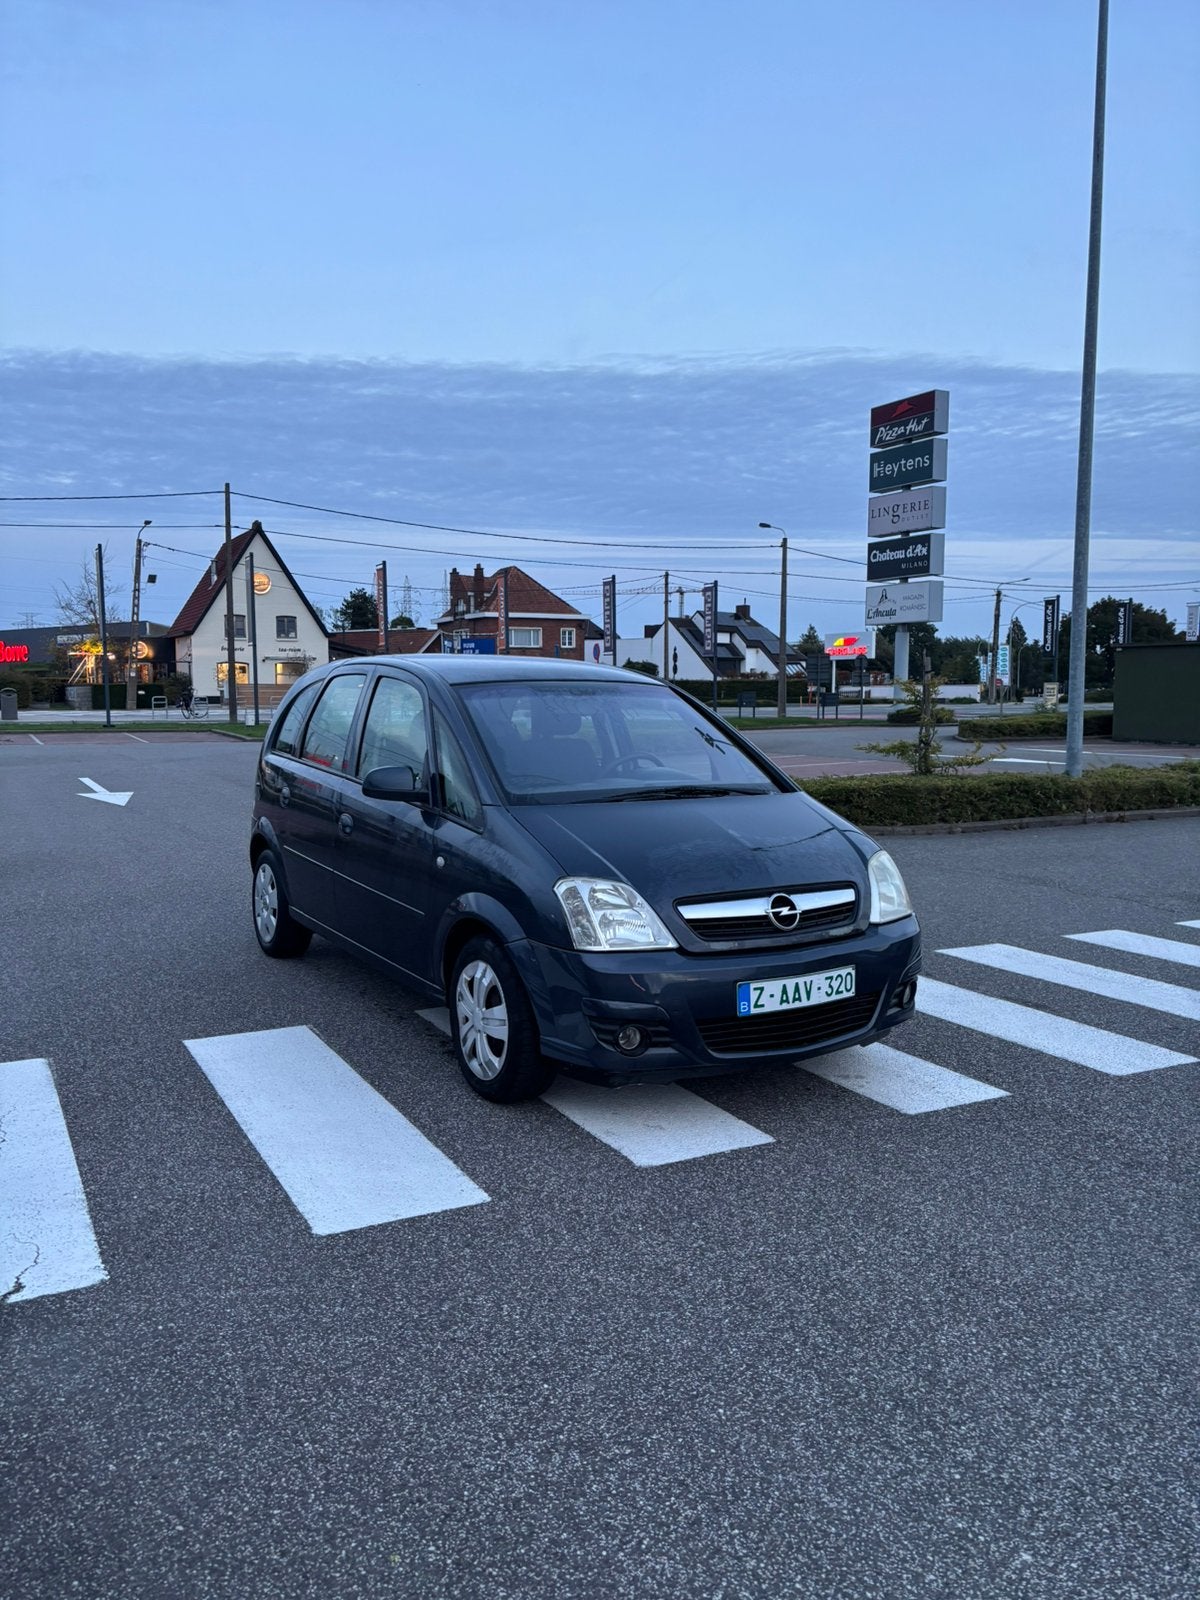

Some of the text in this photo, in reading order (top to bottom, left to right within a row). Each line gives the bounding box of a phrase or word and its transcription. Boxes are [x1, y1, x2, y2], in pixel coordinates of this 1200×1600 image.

[875, 417, 930, 444] Pizza Hut
[873, 455, 930, 478] Heytens
[901, 513, 929, 522] OUTLET
[870, 548, 905, 563] Chateau
[901, 560, 928, 569] MILANO
[740, 1002, 749, 1012] B
